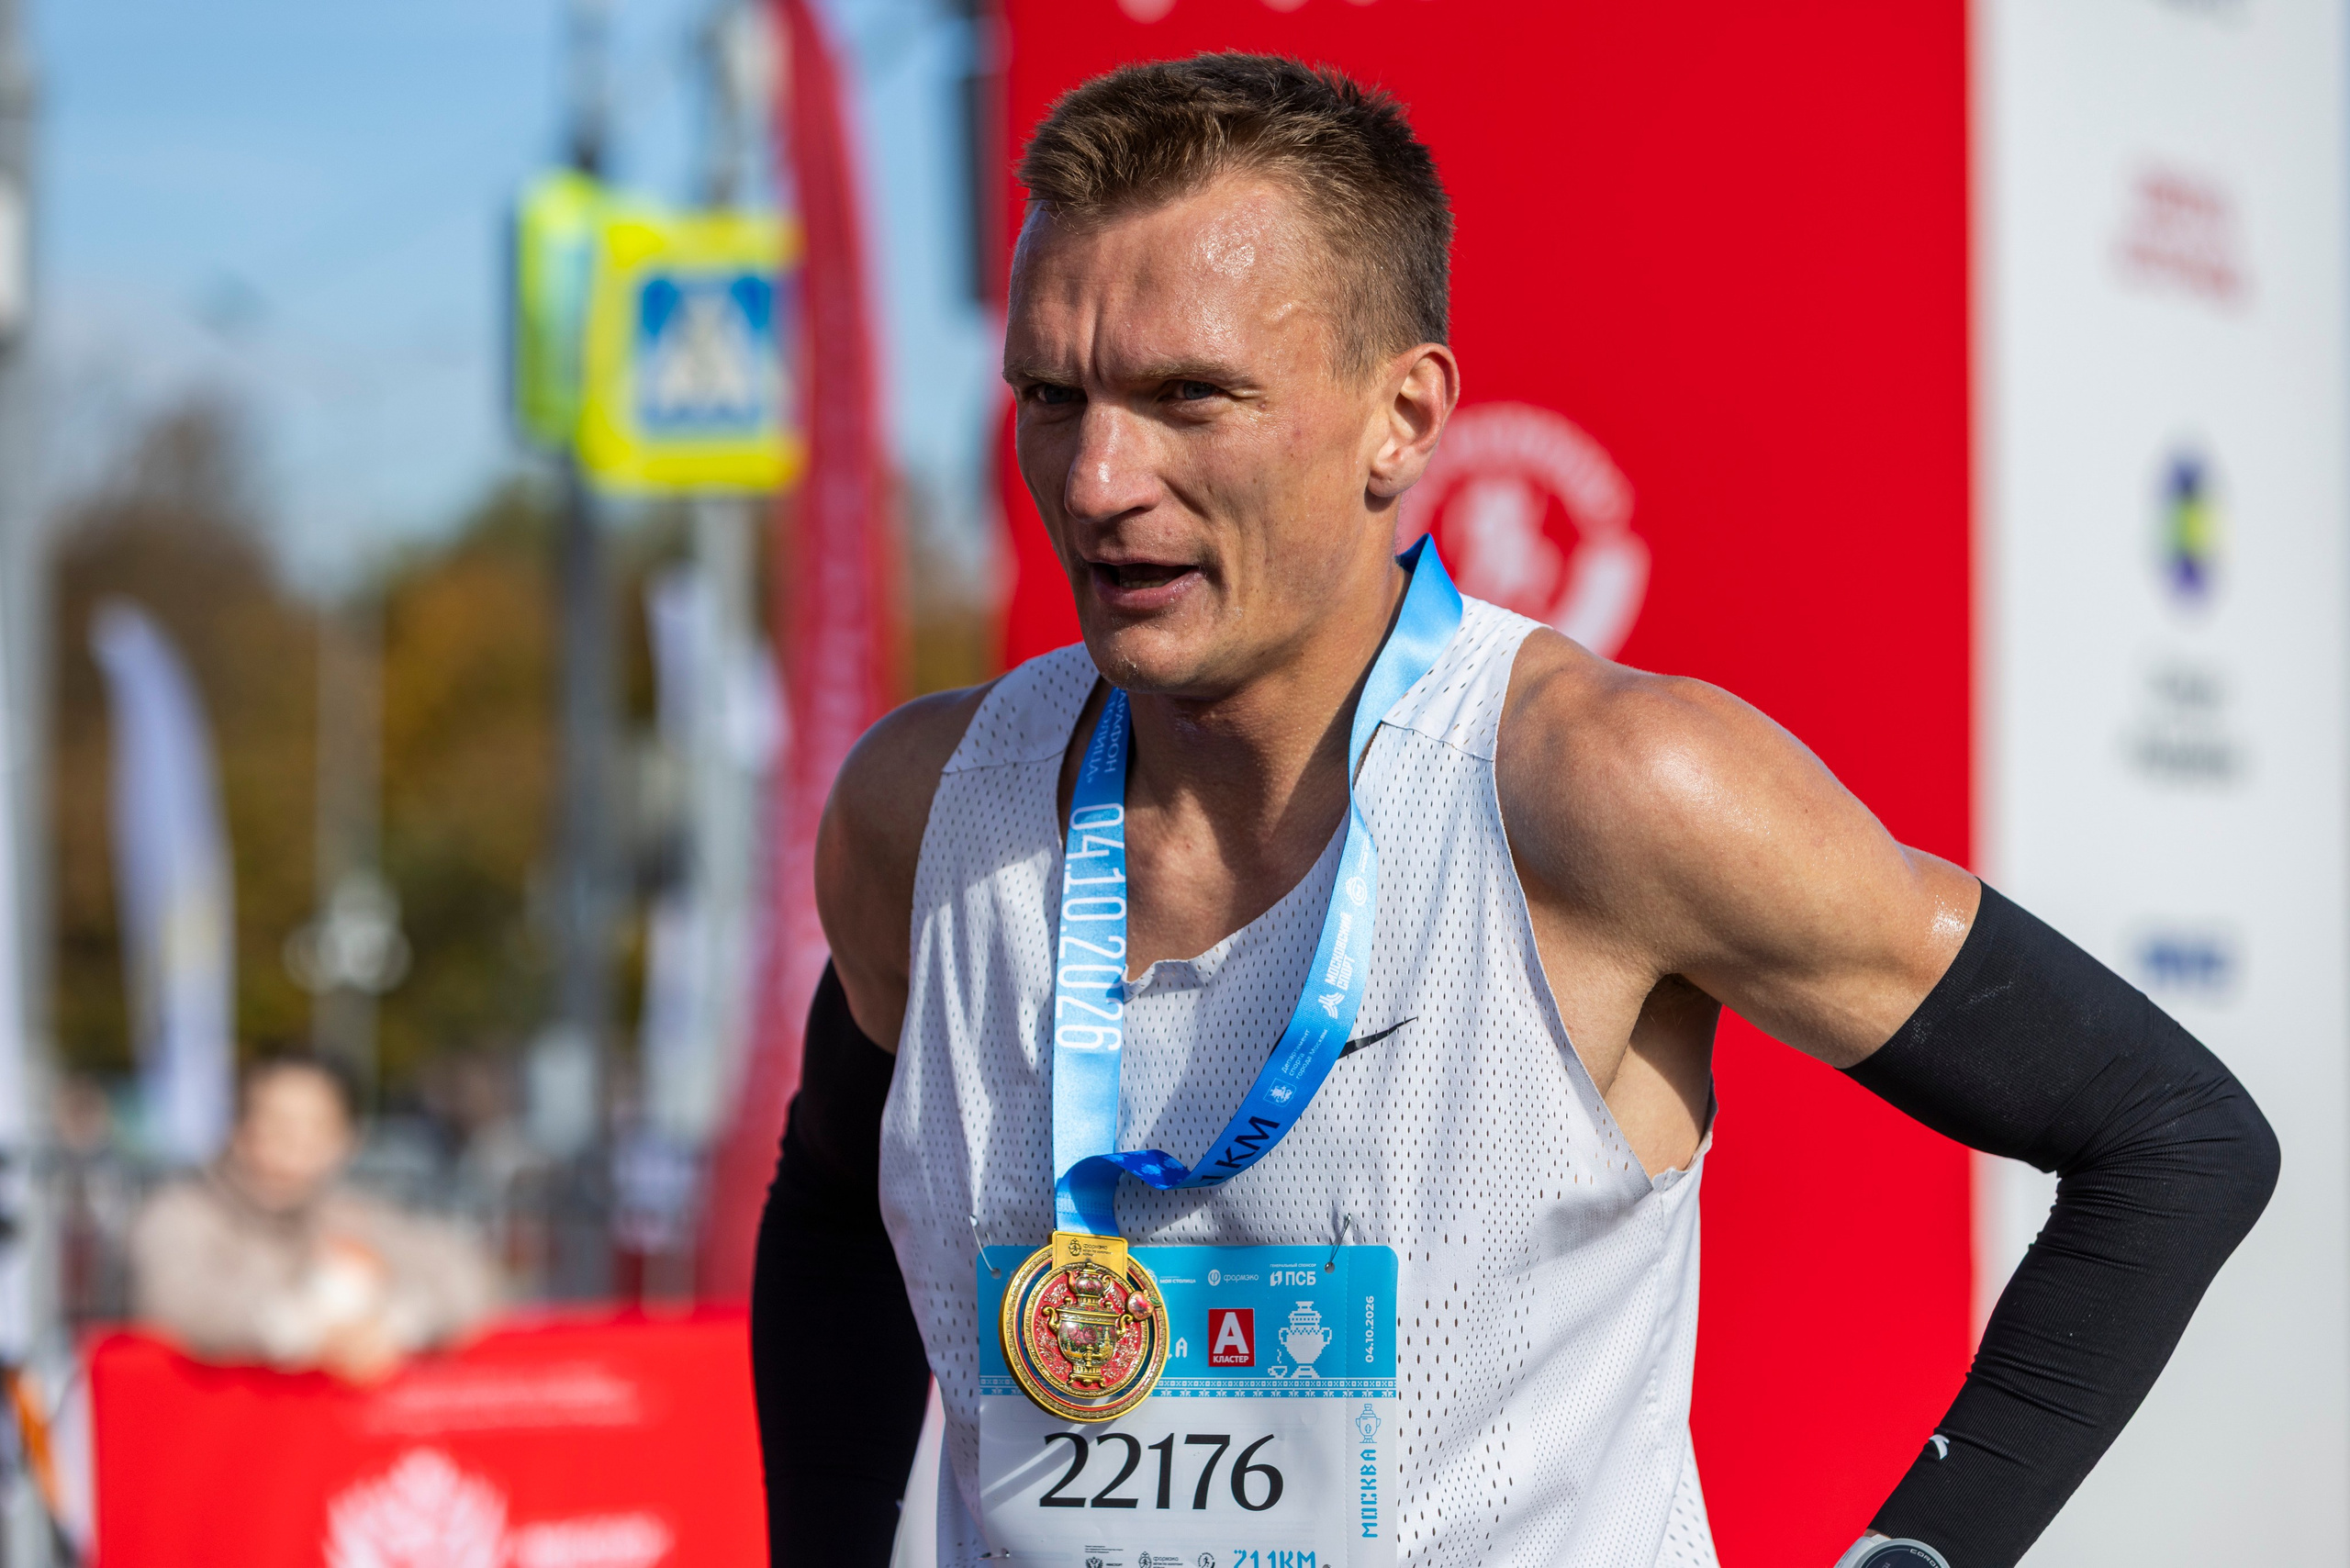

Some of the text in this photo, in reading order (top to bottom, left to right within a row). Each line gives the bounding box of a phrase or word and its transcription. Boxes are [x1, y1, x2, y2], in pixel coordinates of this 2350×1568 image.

[1086, 700, 1115, 784] ТОЛИЦА»
[1104, 691, 1125, 773] АРАФОН
[1055, 802, 1128, 1051] 04.10.2026
[1324, 912, 1353, 986] МОСКОВСКИЙ
[1336, 954, 1356, 991] СПОРТ
[1281, 1028, 1311, 1074] Департамент
[1288, 1052, 1305, 1077] спорта
[1295, 1056, 1313, 1080] города
[1223, 1274, 1259, 1283] формэко
[1285, 1271, 1316, 1286] ПСБ
[1213, 1312, 1249, 1354] А
[1365, 1295, 1374, 1363] 04.10.2026
[1213, 1355, 1249, 1363] КЛАСТЕР
[1038, 1431, 1284, 1512] 22176
[1360, 1449, 1378, 1538] МОСКВА
